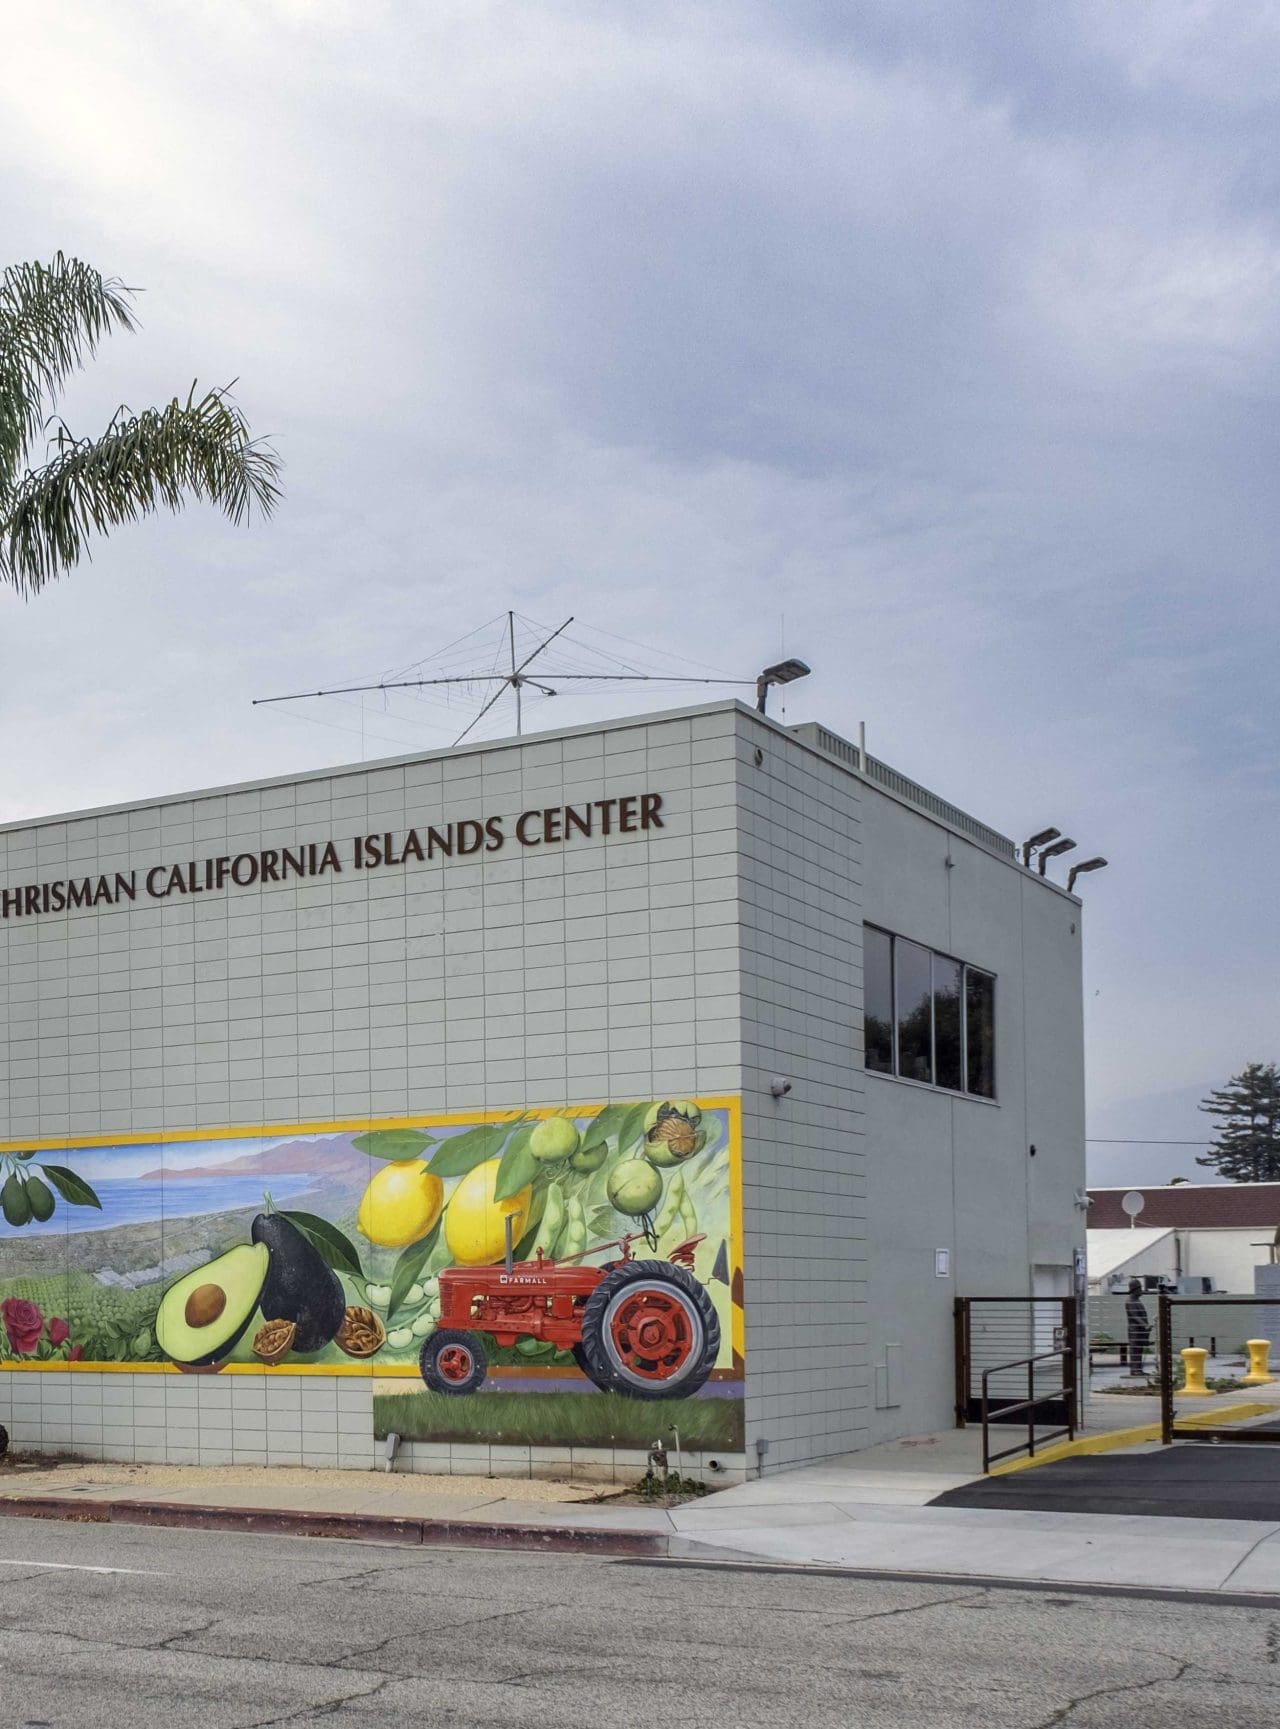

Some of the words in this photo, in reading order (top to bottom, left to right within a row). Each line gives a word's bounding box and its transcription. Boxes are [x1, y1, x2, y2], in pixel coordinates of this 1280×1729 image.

[146, 841, 342, 899] CALIFORNIA
[354, 815, 505, 869] ISLANDS
[516, 793, 664, 846] CENTER
